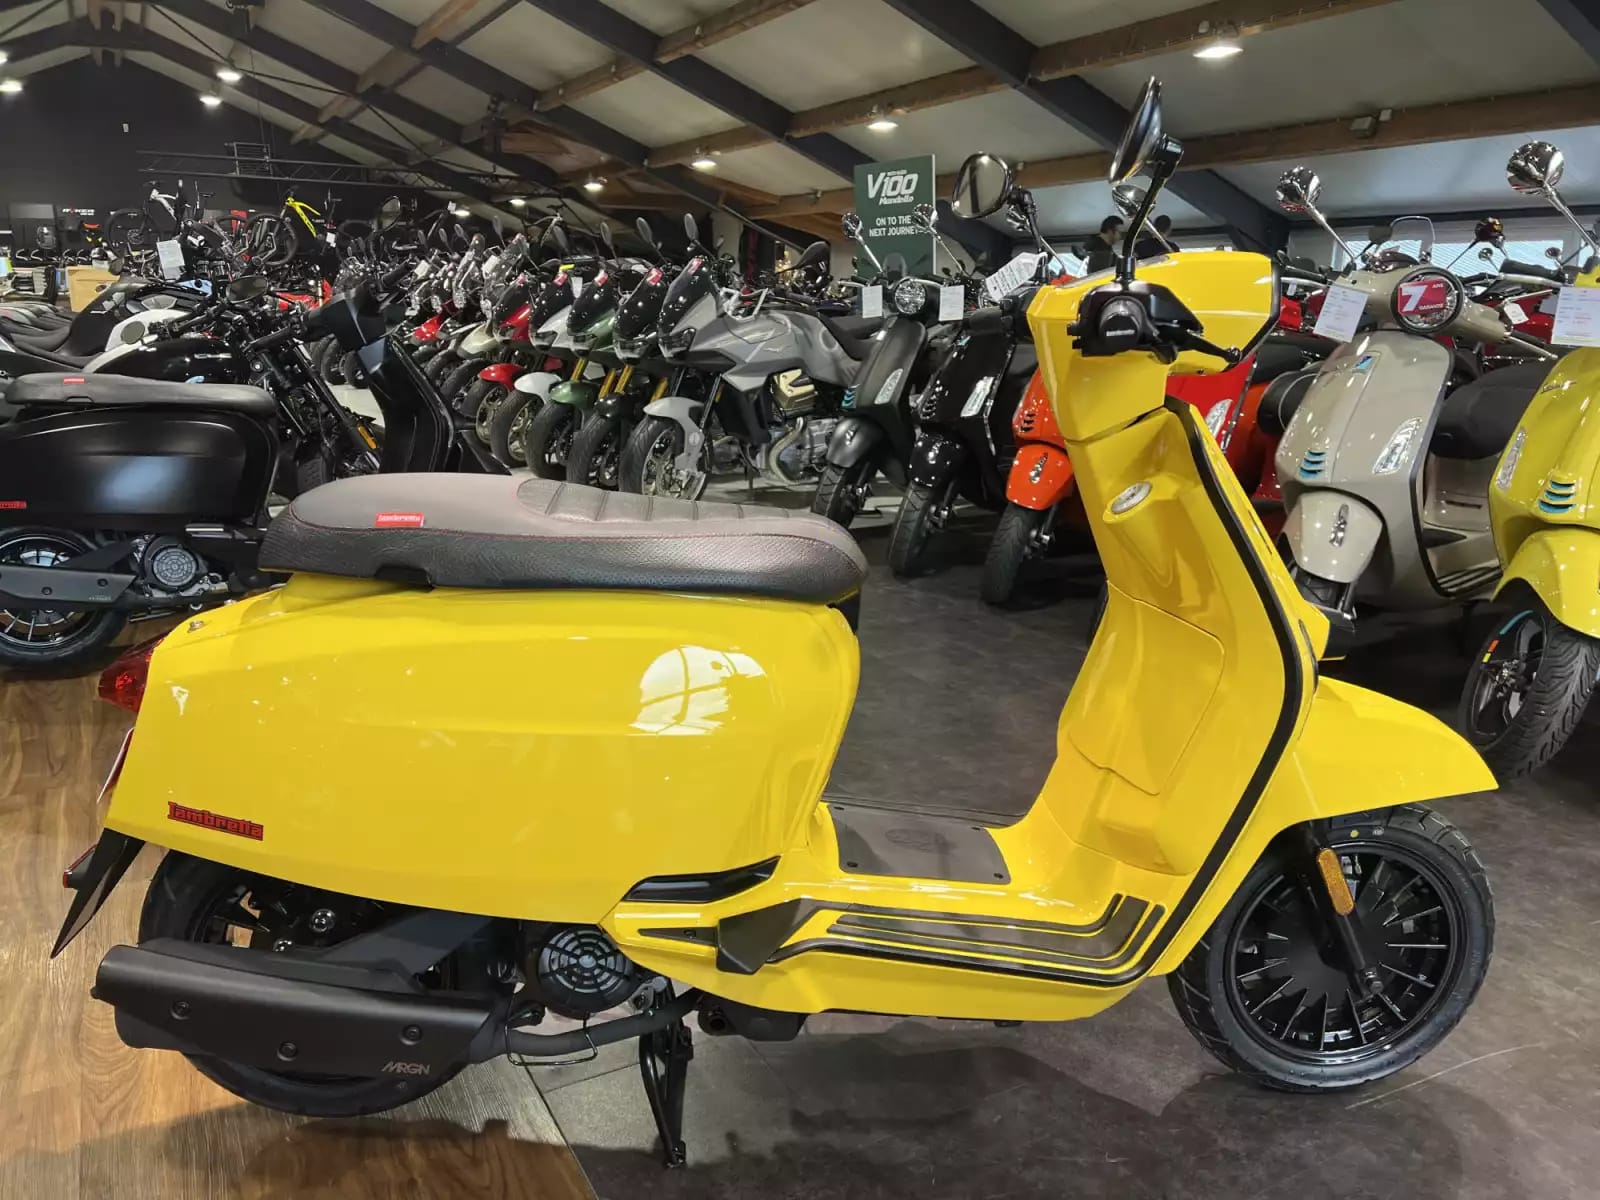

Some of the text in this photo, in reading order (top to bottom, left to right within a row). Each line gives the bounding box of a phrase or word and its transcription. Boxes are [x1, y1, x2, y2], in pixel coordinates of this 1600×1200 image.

[867, 172, 919, 199] V100
[875, 215, 912, 226] ON TO THE
[869, 227, 887, 237] NEXT
[1402, 284, 1428, 312] 7
